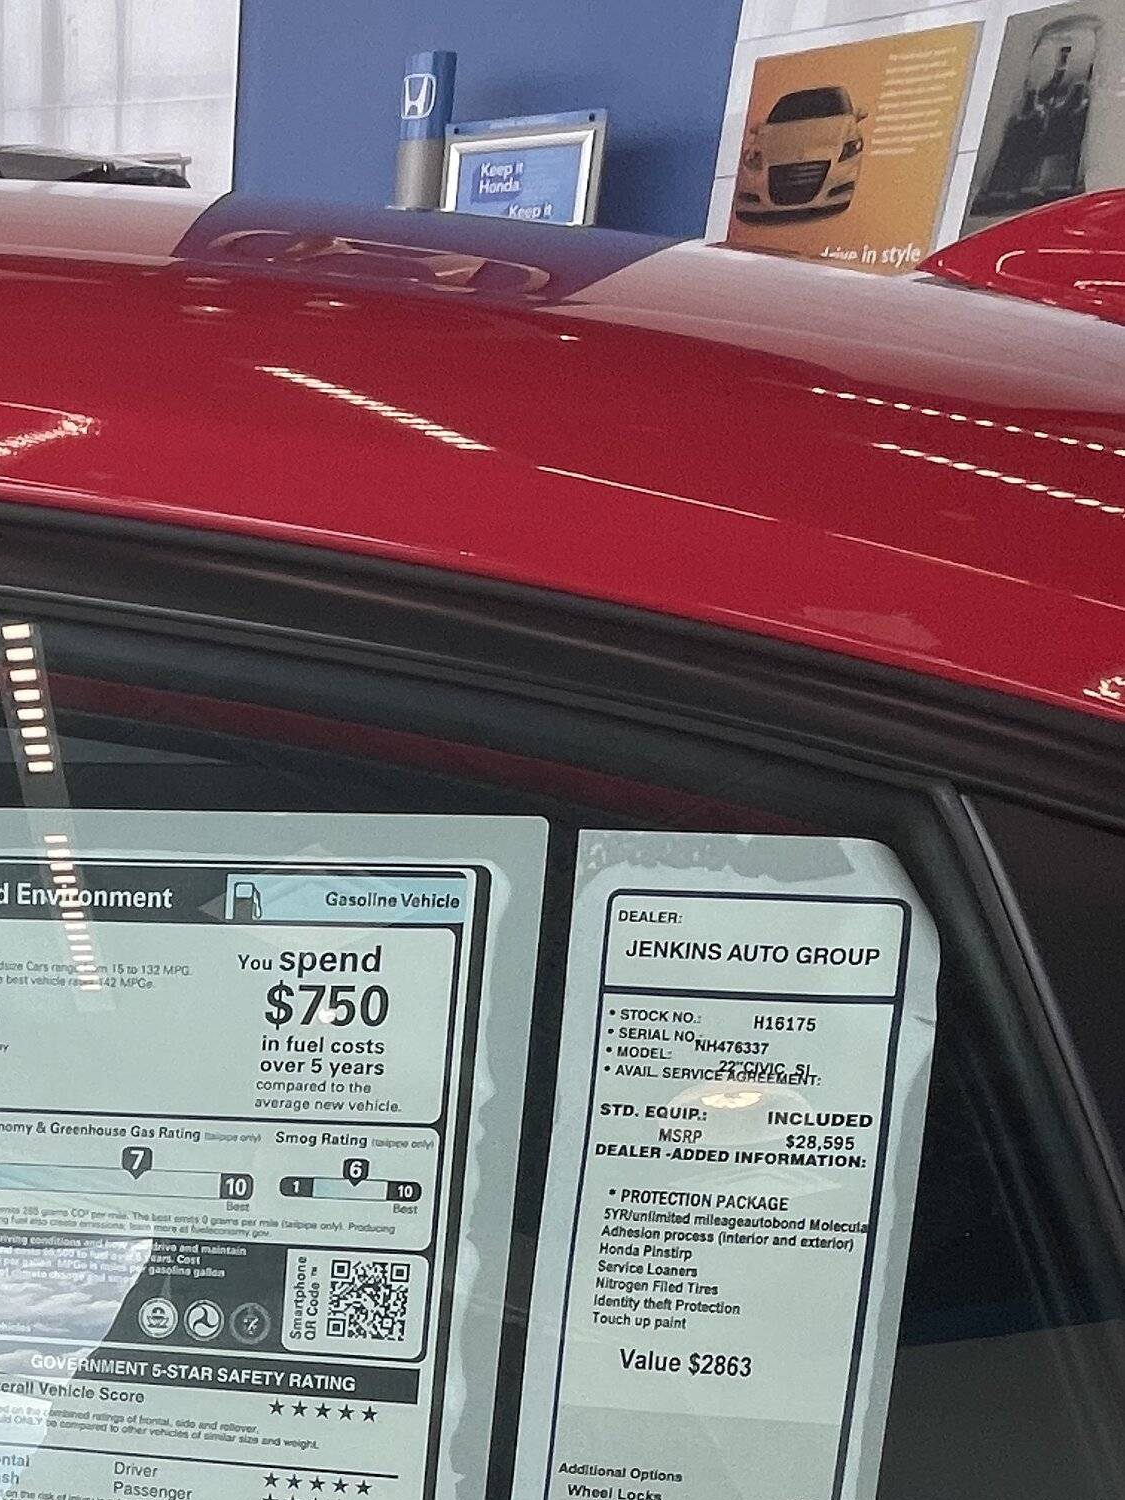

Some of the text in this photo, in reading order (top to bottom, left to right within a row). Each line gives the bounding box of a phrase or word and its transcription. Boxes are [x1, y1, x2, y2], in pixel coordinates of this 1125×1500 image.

[481, 162, 524, 179] Keep it
[509, 202, 553, 218] Keep it
[861, 244, 876, 263] in
[882, 243, 921, 268] style
[17, 882, 173, 909] Environment
[326, 891, 460, 909] Gasoline Vehicle
[618, 909, 683, 924] DEALER:
[237, 946, 382, 978] You spend
[626, 940, 880, 966] JENKINS AUTO GROUP
[264, 979, 389, 1031] $750
[620, 1009, 668, 1022] STOCK
[753, 1015, 816, 1032] H16175
[261, 1035, 385, 1055] in fuel costs
[695, 1039, 769, 1055] NH476337
[260, 1058, 384, 1078] over 5 years
[256, 1080, 371, 1096] compared to the
[254, 1098, 402, 1114] average new vehicle.
[600, 1103, 639, 1118] STD.
[767, 1111, 873, 1128] INCLUDED
[36, 1122, 46, 1134] &
[50, 1121, 127, 1138] Greenhouse
[131, 1125, 155, 1139] Gas
[159, 1126, 201, 1142] Rating
[276, 1131, 367, 1149] Smog Rating
[658, 1128, 855, 1151] MSRP $28,595
[131, 1150, 144, 1170] 7
[226, 1178, 246, 1196] 10
[293, 1162, 413, 1198] 1 6 10
[226, 1201, 249, 1212] Best
[393, 1204, 418, 1214] Best
[621, 1188, 789, 1211] PROTECTION PACKAGE
[289, 1256, 307, 1341] Smartphone
[305, 1281, 319, 1341] QR Code
[31, 1354, 356, 1392] GOVERNMENT 5-STAR SAFETY RATING
[620, 1349, 752, 1378] Value $2863
[39, 1381, 95, 1400] Vehicle
[99, 1386, 145, 1404] Score
[115, 1461, 157, 1479] Driver
[113, 1480, 192, 1500] Passenger
[567, 1484, 613, 1499] Wheel
